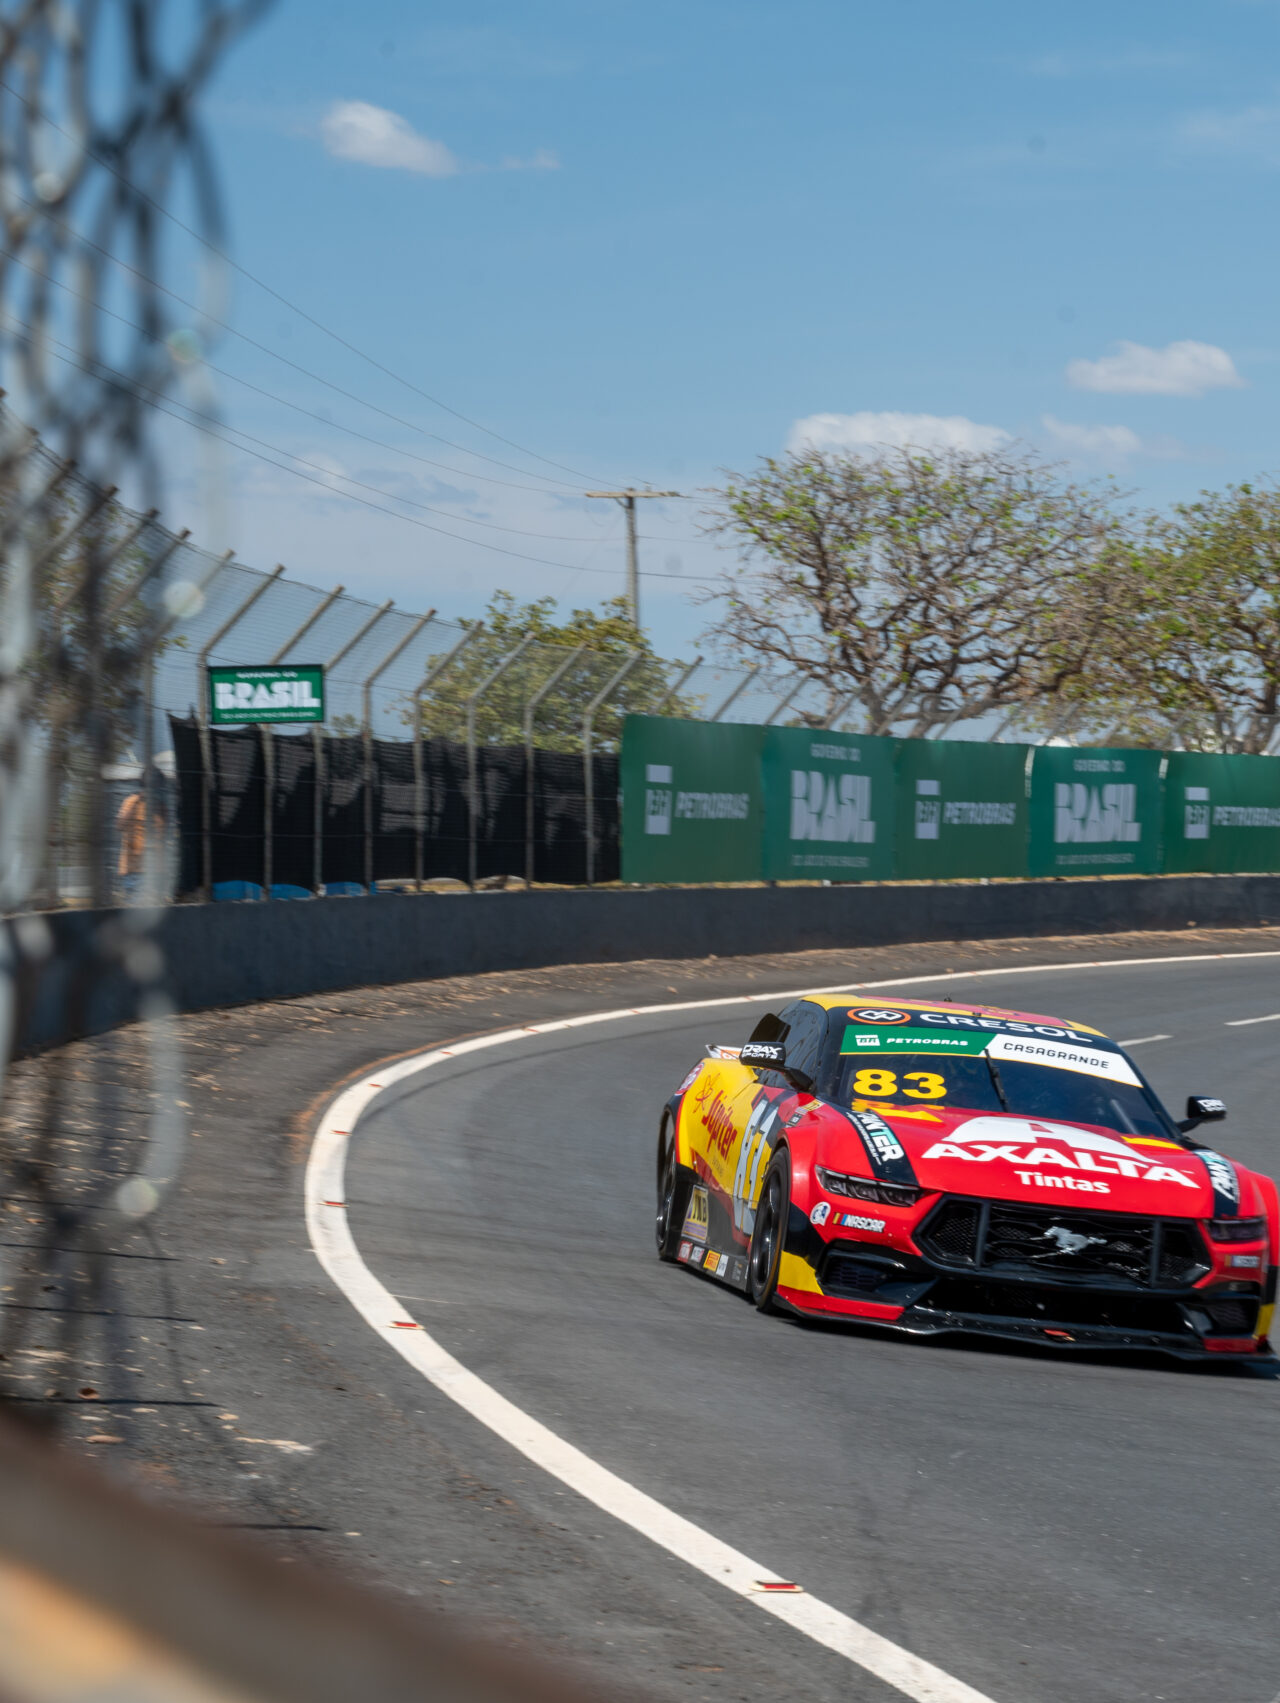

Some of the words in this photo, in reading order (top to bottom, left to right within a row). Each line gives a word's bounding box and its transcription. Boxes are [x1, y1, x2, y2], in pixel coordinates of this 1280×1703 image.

[214, 681, 321, 710] BRASIL
[675, 790, 749, 820] PETROBRAS
[790, 769, 876, 843] BRASIL
[943, 802, 1016, 825] PETROBRAS
[1054, 782, 1142, 843] BRASIL
[886, 1038, 969, 1046] PETROBRAS
[919, 1013, 1093, 1043] CRESOL
[1003, 1042, 1109, 1069] CASAGRANDE
[853, 1068, 948, 1100] 83
[921, 1143, 1201, 1189] AXALTA
[1014, 1170, 1111, 1193] Tintas
[844, 1214, 886, 1233] NASCAR
